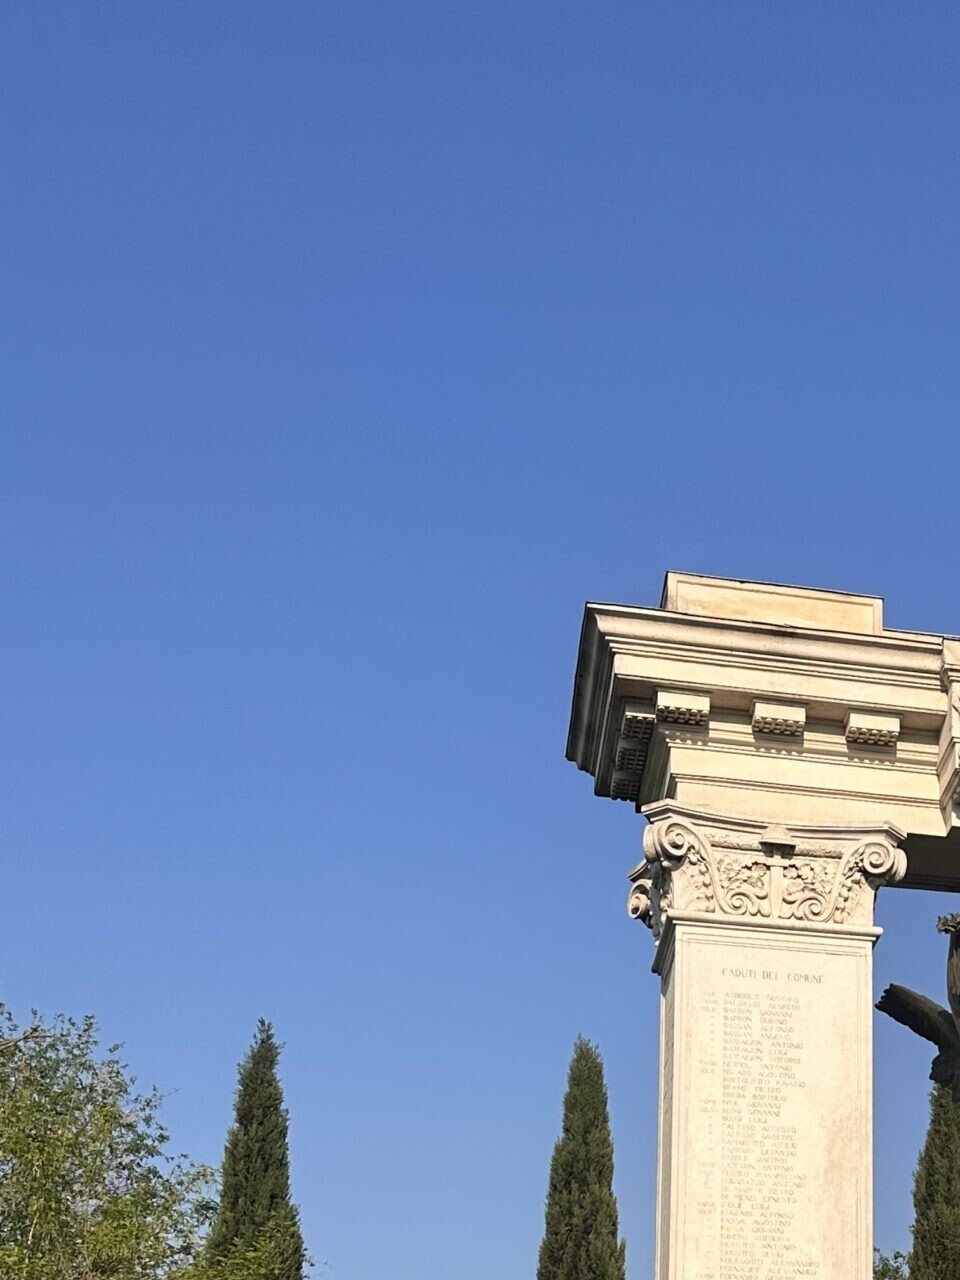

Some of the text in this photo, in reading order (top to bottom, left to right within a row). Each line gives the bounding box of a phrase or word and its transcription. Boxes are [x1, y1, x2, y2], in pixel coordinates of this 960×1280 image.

[722, 968, 824, 984] CADUTI DEL COMUNE
